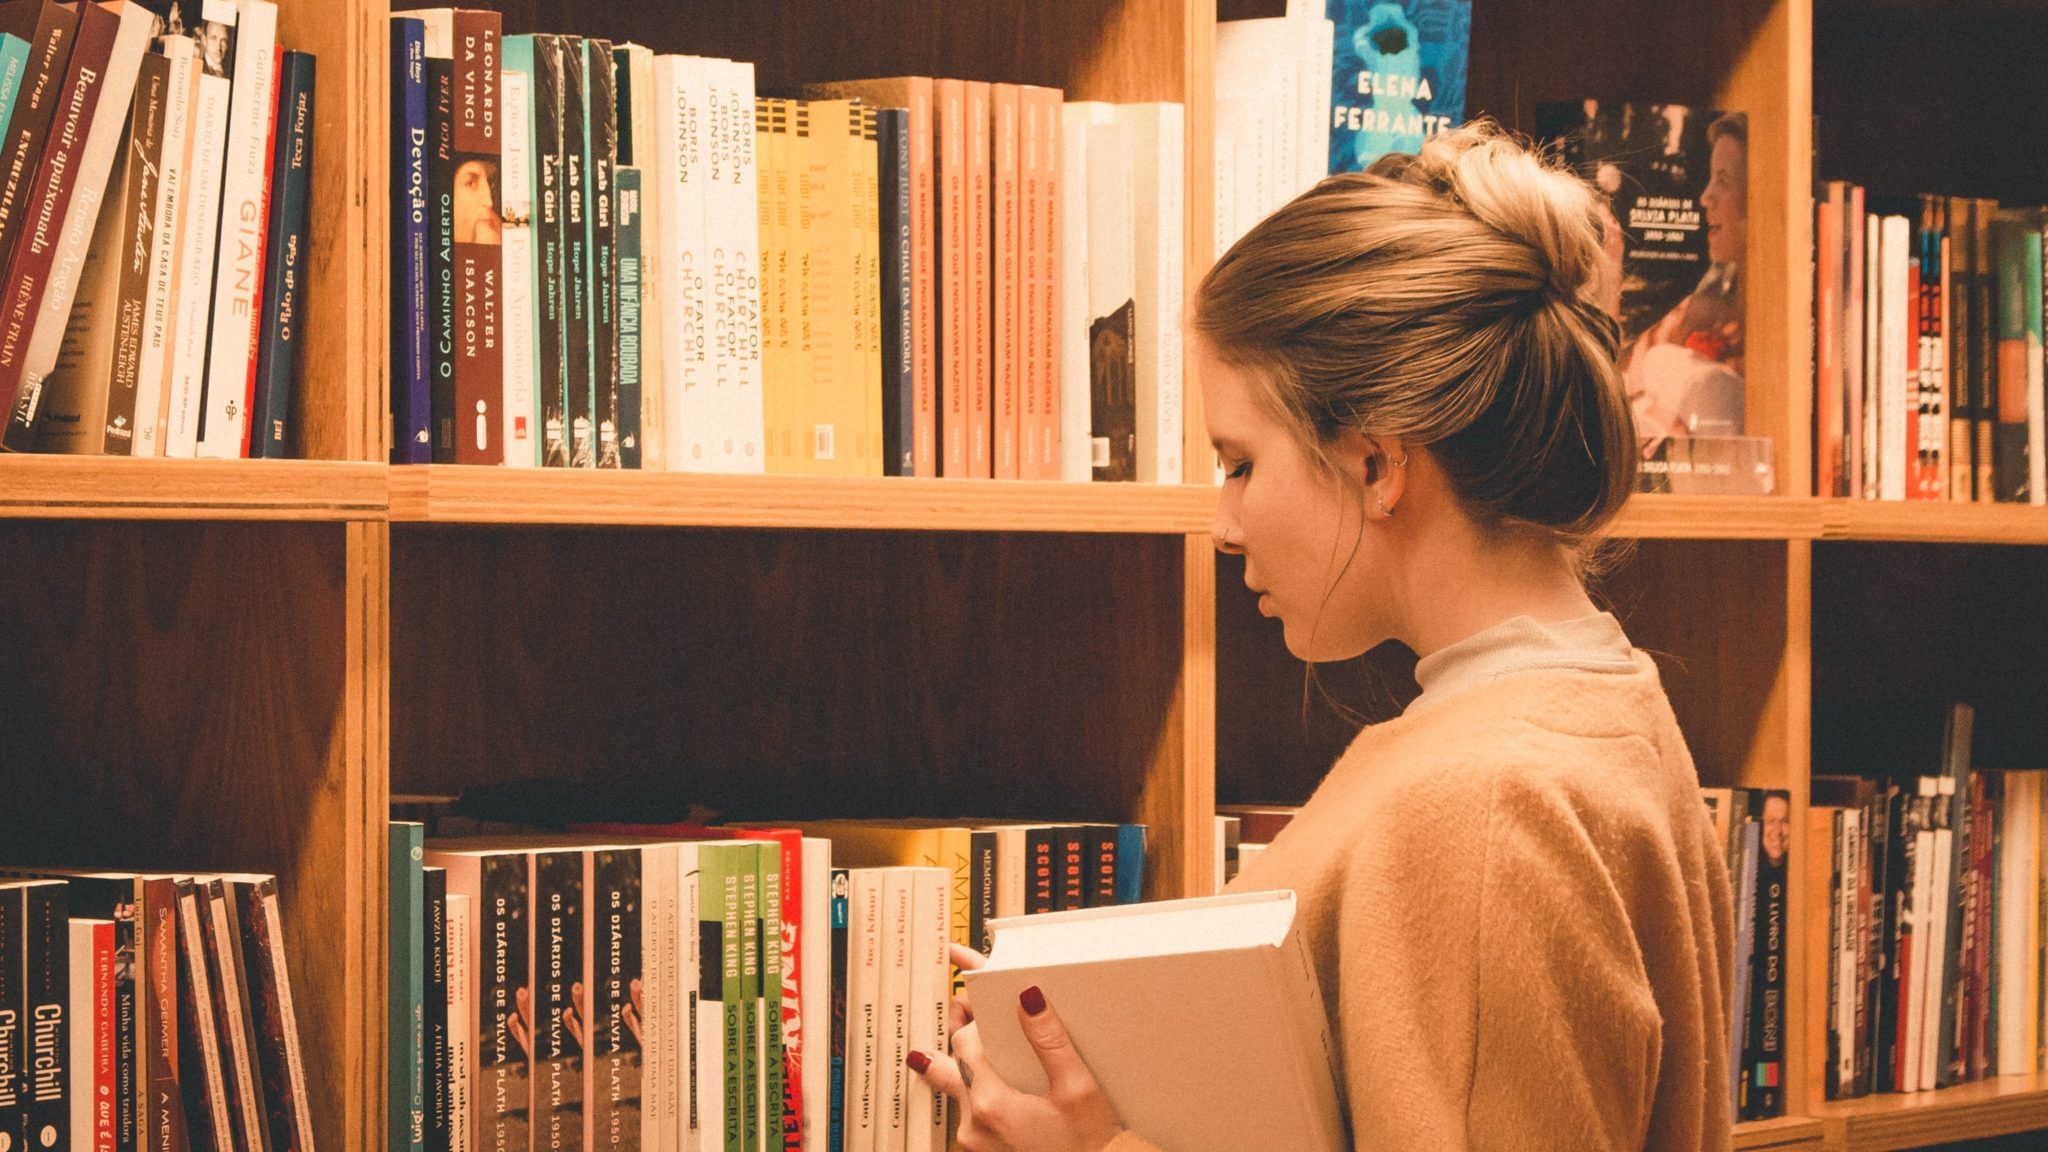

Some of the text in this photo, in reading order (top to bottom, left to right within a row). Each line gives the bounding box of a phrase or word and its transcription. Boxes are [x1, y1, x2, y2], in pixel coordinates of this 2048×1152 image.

[31, 28, 62, 109] Walter Fraga
[465, 36, 475, 127] DA VINCI
[484, 29, 493, 138] LEONARDO
[1357, 70, 1432, 100] ELENA
[247, 49, 268, 175] Guilherme Fiuza
[292, 92, 307, 170] Teca Forjaz
[439, 75, 449, 160] PICO IYER
[678, 87, 688, 182] JOHNSON
[689, 108, 698, 164] BORIS
[709, 86, 719, 180] JOHNSON
[720, 105, 729, 161] BORIS
[731, 91, 741, 184] JOHNSON
[743, 110, 751, 165] BORIS
[1334, 106, 1450, 136] FERRANTE
[31, 66, 97, 254] Beauvoir apaixonada
[408, 127, 425, 223] Devoção
[543, 154, 555, 223] Lab Girl
[569, 154, 581, 224] Lab Girl
[900, 128, 909, 214] TONY JUDT
[598, 159, 609, 227] Lab Girl
[1668, 210, 1700, 224] PLATH
[50, 186, 98, 311] Renato Aragão
[152, 169, 176, 349] VAI EMBORA DA CASA DE TEUS PAIS
[233, 200, 257, 317] GIANE
[572, 241, 580, 273] Hope
[902, 225, 910, 236] O
[285, 270, 294, 290] da
[440, 193, 451, 377] O CAMINHO ABERTO
[546, 241, 555, 320] Hope Jahren
[600, 245, 608, 278] Hope
[465, 259, 476, 357] ISAACSON
[485, 270, 494, 349] WALTER
[620, 258, 640, 385] UMA INFÂNCIA ROUBADA
[682, 251, 695, 392] CHURCHILL
[695, 277, 704, 361] O FATOR
[714, 248, 727, 387] CHURCHILL
[726, 273, 735, 357] O FATOR
[736, 251, 748, 385] CHURCHILL
[748, 277, 758, 360] O FATOR
[902, 287, 911, 304] DA
[920, 279, 928, 355] ENGANAVAM
[0, 324, 21, 367] FRAIN
[126, 300, 142, 388] JAMES EDWARD
[282, 326, 290, 340] O
[611, 891, 620, 908] OS
[1036, 844, 1049, 898] SCOTT
[1067, 842, 1080, 896] SCOTT
[1101, 842, 1114, 896] SCOTT
[1768, 883, 1780, 900] O
[496, 898, 505, 915] OS
[552, 894, 561, 911] OS
[725, 876, 737, 977] STEPHEN KING
[744, 874, 756, 975] STEPHEN KING
[767, 874, 779, 974] STEPHEN KING
[954, 853, 969, 947] AMYR
[1768, 903, 1780, 950] LIVRO
[433, 900, 442, 983] FAWZIA KOOFI
[496, 922, 507, 983] DIÁRIOS
[552, 918, 563, 978] DIÁRIOS
[611, 915, 623, 974] DIÁRIOS
[1766, 957, 1779, 983] DO
[99, 950, 109, 1074] FERNANDO GABEIRA
[121, 994, 132, 1027] Minha
[159, 907, 169, 1058] SAMANTHA GEIMER
[496, 990, 505, 1006] DE
[551, 984, 560, 1001] DE
[611, 981, 620, 998] DE
[35, 1003, 62, 1101] Churchill
[122, 1030, 132, 1060] vida
[435, 1024, 442, 1032] A
[496, 1014, 506, 1063] SYLVIA
[551, 1008, 561, 1057] SYLVIA
[611, 1004, 620, 1052] SYLVIA
[99, 1085, 110, 1095] O
[161, 1093, 169, 1104] A
[497, 1070, 505, 1113] PLATH
[552, 1063, 560, 1106] PLATH
[611, 1058, 620, 1101] PLATH
[728, 1004, 737, 1142] SOBRE A ESCRITA
[746, 1002, 756, 1139] SOBRE A ESCRITA
[768, 1001, 778, 1136] SOBRE A ESCRITA
[99, 1102, 110, 1127] QUE
[122, 1098, 133, 1143] traidora
[411, 1110, 424, 1143] Luigi
[414, 1095, 422, 1105] O
